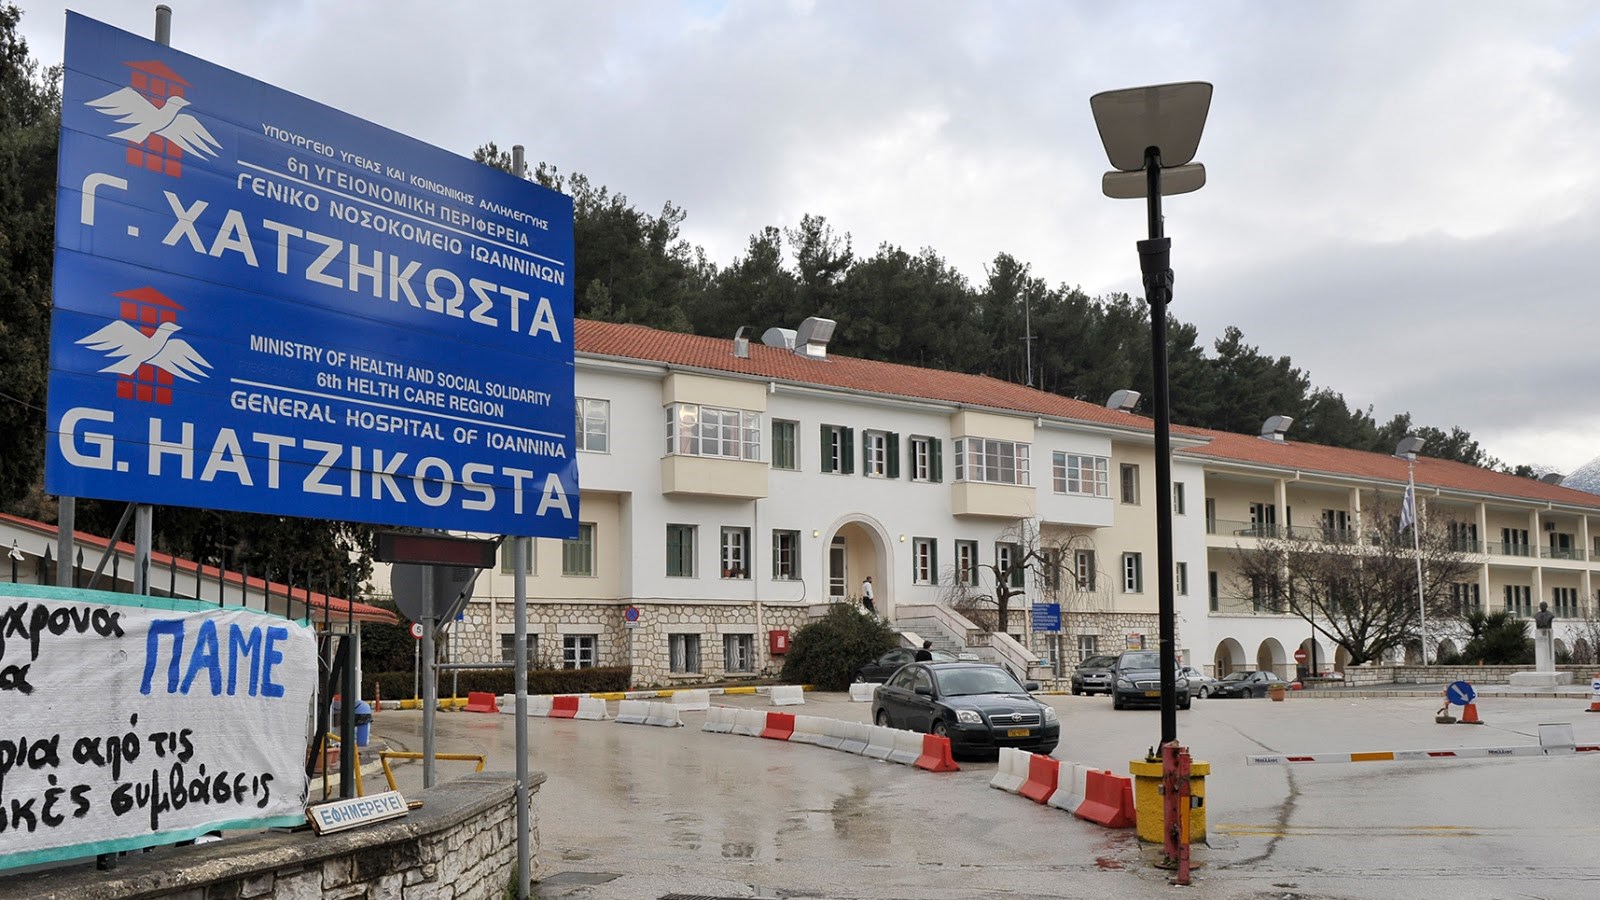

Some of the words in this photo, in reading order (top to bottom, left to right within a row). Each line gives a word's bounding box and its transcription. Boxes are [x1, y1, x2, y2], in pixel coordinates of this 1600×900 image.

[262, 123, 334, 158] ΥΠΟΥΡΓΕΙΟ
[340, 150, 382, 174] ΥΓΕΙΑΣ
[386, 166, 405, 182] ΚΑΙ
[410, 174, 475, 206] ΚΟΙΝΩΝΙΚΗΣ
[479, 199, 549, 231] ΑΛΛΗΛΕΓΓΥΗΣ
[287, 156, 309, 180] 6η
[315, 164, 435, 217] ΥΓΕΙΟΝΟΜΙΚΗ
[440, 206, 529, 247] ΠΕΡΙΦΕΡΕΙΑ
[80, 172, 139, 238] Γ.
[161, 190, 562, 344] ΧΑΤΖΗΚΩΣΤΑ
[237, 173, 320, 212] ΓΕΝΙΚΟ
[329, 200, 463, 255] ΝΟΣΟΚΟΜΕΙΟ
[470, 244, 565, 286] ΙΩΑΝΝΙΝΩΝ
[250, 334, 323, 363] MINISTRY
[326, 350, 347, 367] OF
[350, 354, 403, 379] HEALTH
[406, 366, 434, 385] AND
[437, 372, 483, 395] SOCIAL
[485, 381, 552, 407] SOLIDARITY
[316, 372, 342, 390] 6th
[347, 376, 399, 400] HELTH
[403, 387, 446, 408] CARE
[449, 395, 504, 418] REGION
[230, 390, 337, 424] GENERAL
[346, 408, 445, 441] HOSPITAL
[453, 427, 478, 445] OF
[486, 432, 567, 459] IOANNINA
[58, 406, 130, 473] G.
[148, 416, 574, 520] HATZIKOSTA
[140, 618, 289, 698] ΠΑΜΕ
[72, 713, 141, 783] από
[148, 728, 194, 764] τις
[111, 762, 274, 831] συμβάσεις
[320, 795, 403, 826] ΕΦΗΜΕΡΕΥΕΙ
